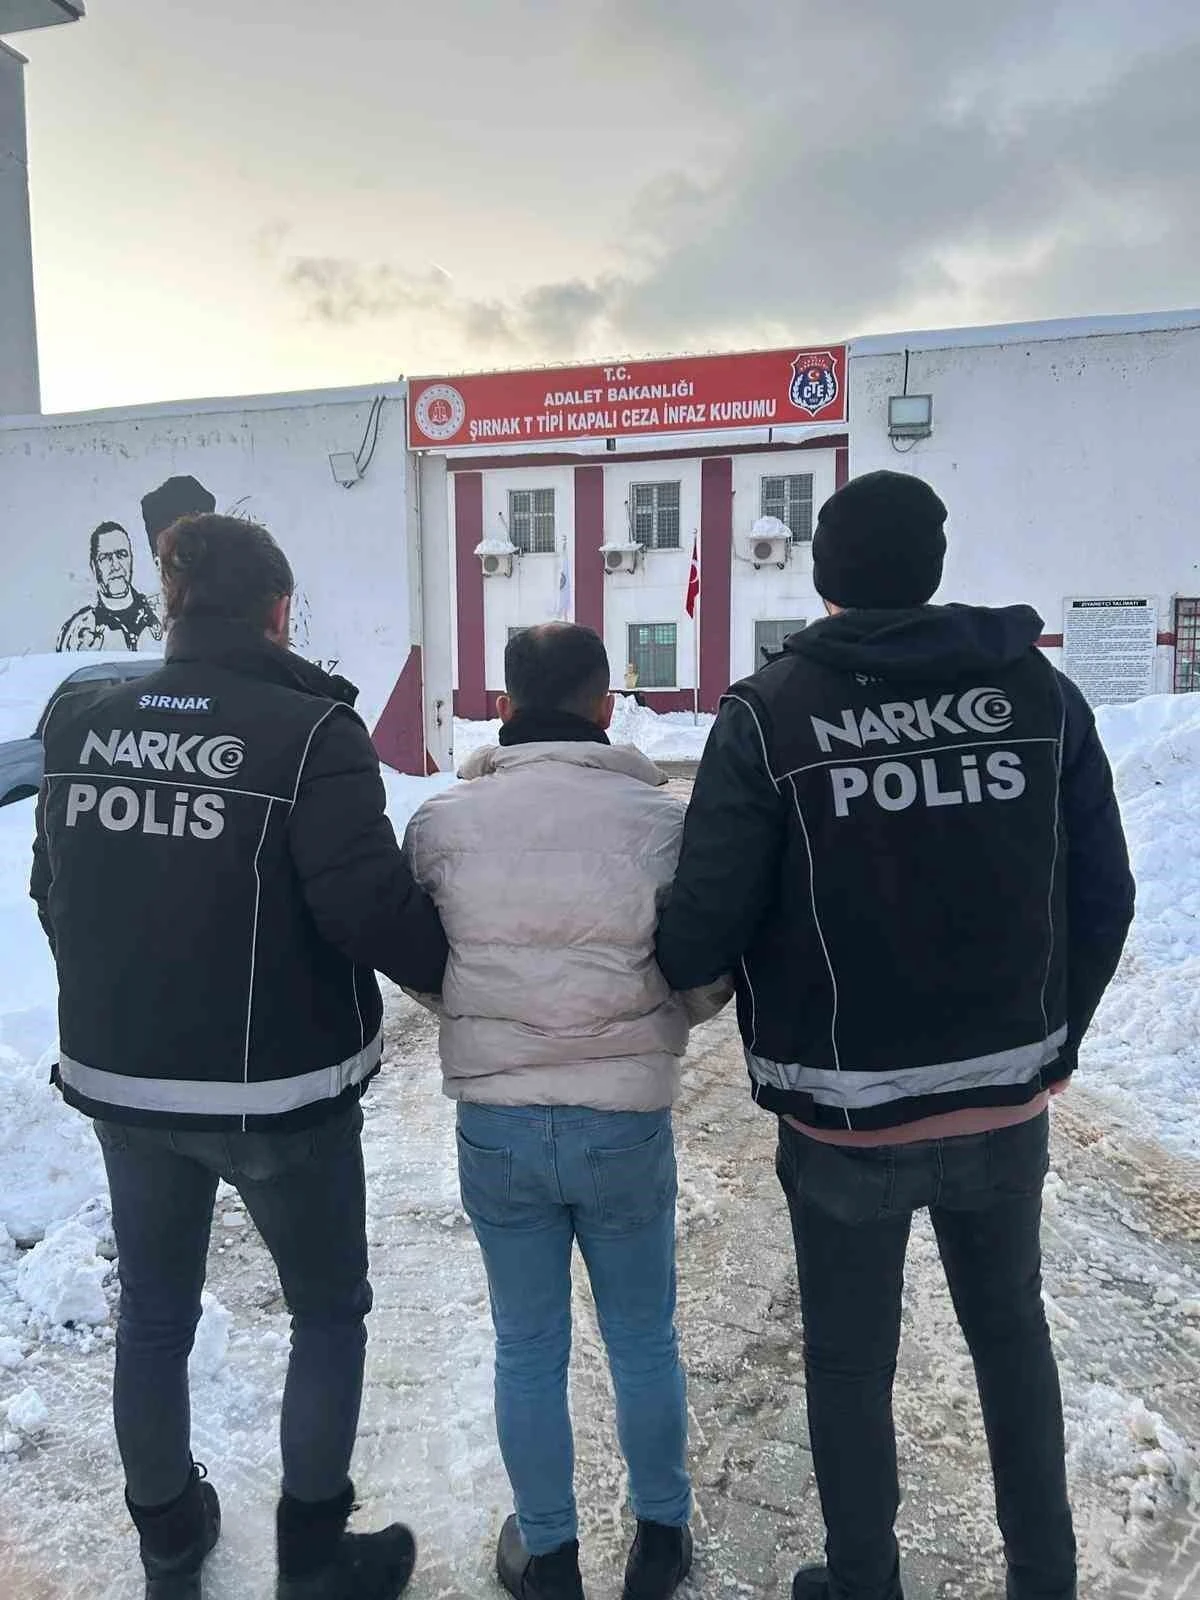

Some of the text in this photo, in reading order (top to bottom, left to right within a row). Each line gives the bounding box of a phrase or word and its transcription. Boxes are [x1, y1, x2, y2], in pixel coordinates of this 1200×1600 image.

[604, 367, 631, 381] T.C.
[544, 379, 694, 406] ADALET BAKANLIĞI
[469, 399, 777, 441] ŞIRNAK T TİPİ KAPALI CEZA İNFAZ KURUMU
[138, 694, 212, 711] ŞIRNAK
